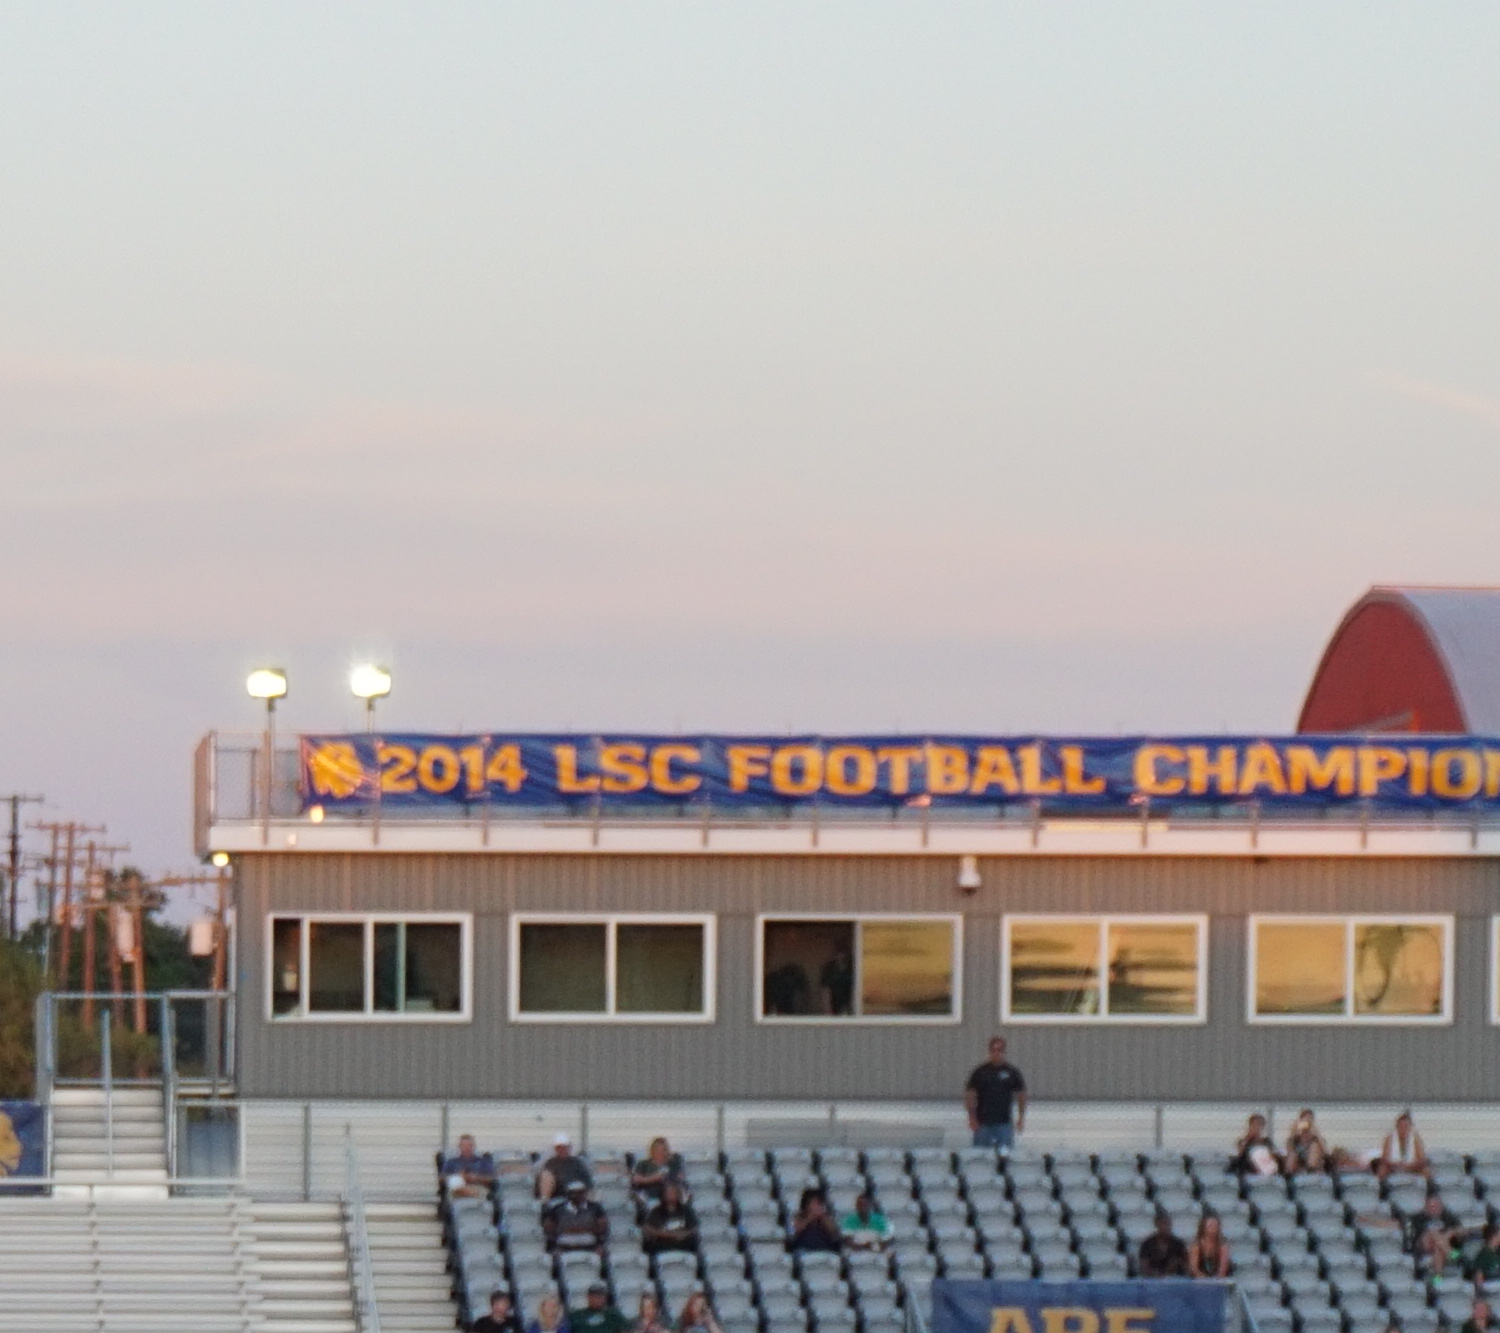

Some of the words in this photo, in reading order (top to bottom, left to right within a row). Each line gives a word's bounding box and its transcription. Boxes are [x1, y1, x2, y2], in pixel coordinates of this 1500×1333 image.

[379, 746, 525, 794] 2014
[554, 742, 703, 795] LSC
[729, 742, 1104, 798] FOOTBALL
